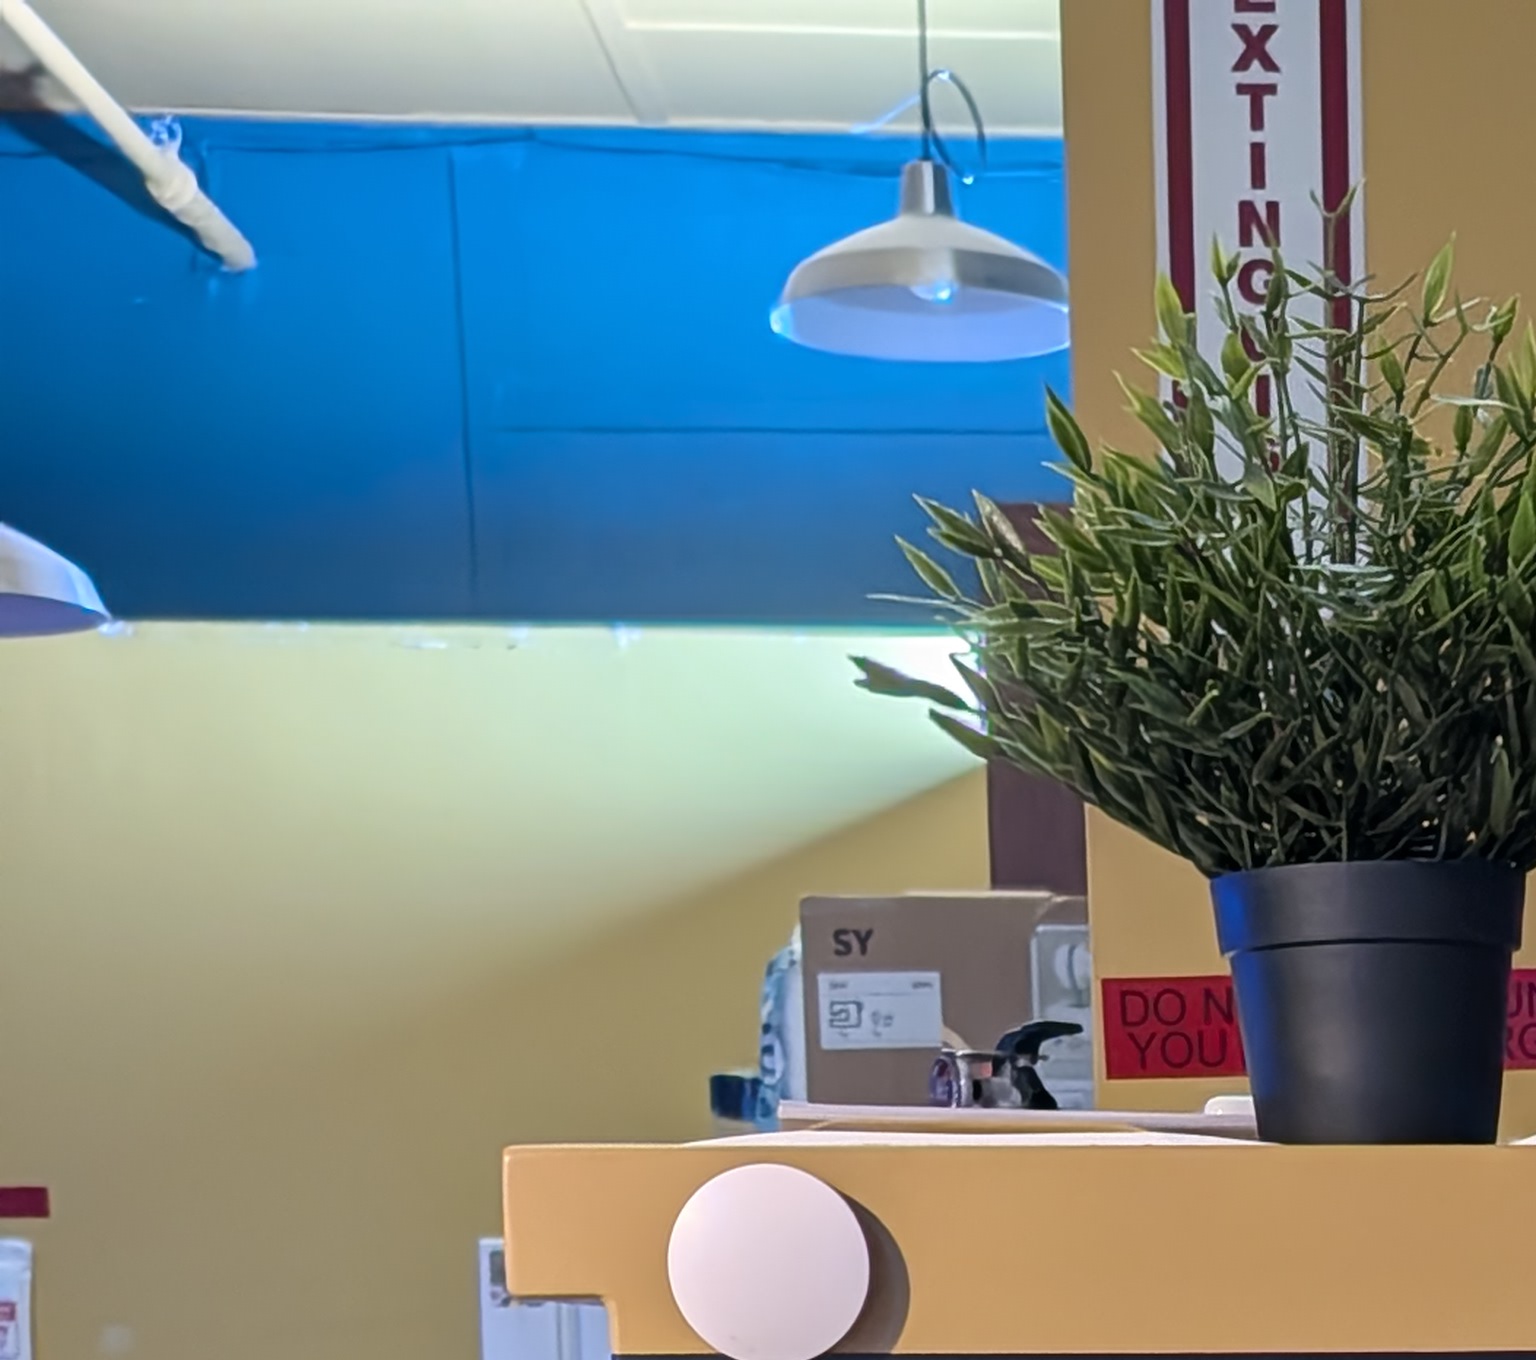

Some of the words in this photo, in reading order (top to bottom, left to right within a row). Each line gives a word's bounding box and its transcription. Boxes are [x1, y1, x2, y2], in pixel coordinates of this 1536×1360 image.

[833, 928, 873, 956] SY
[1120, 988, 1187, 1027] DO
[1127, 1029, 1228, 1071] YOU
